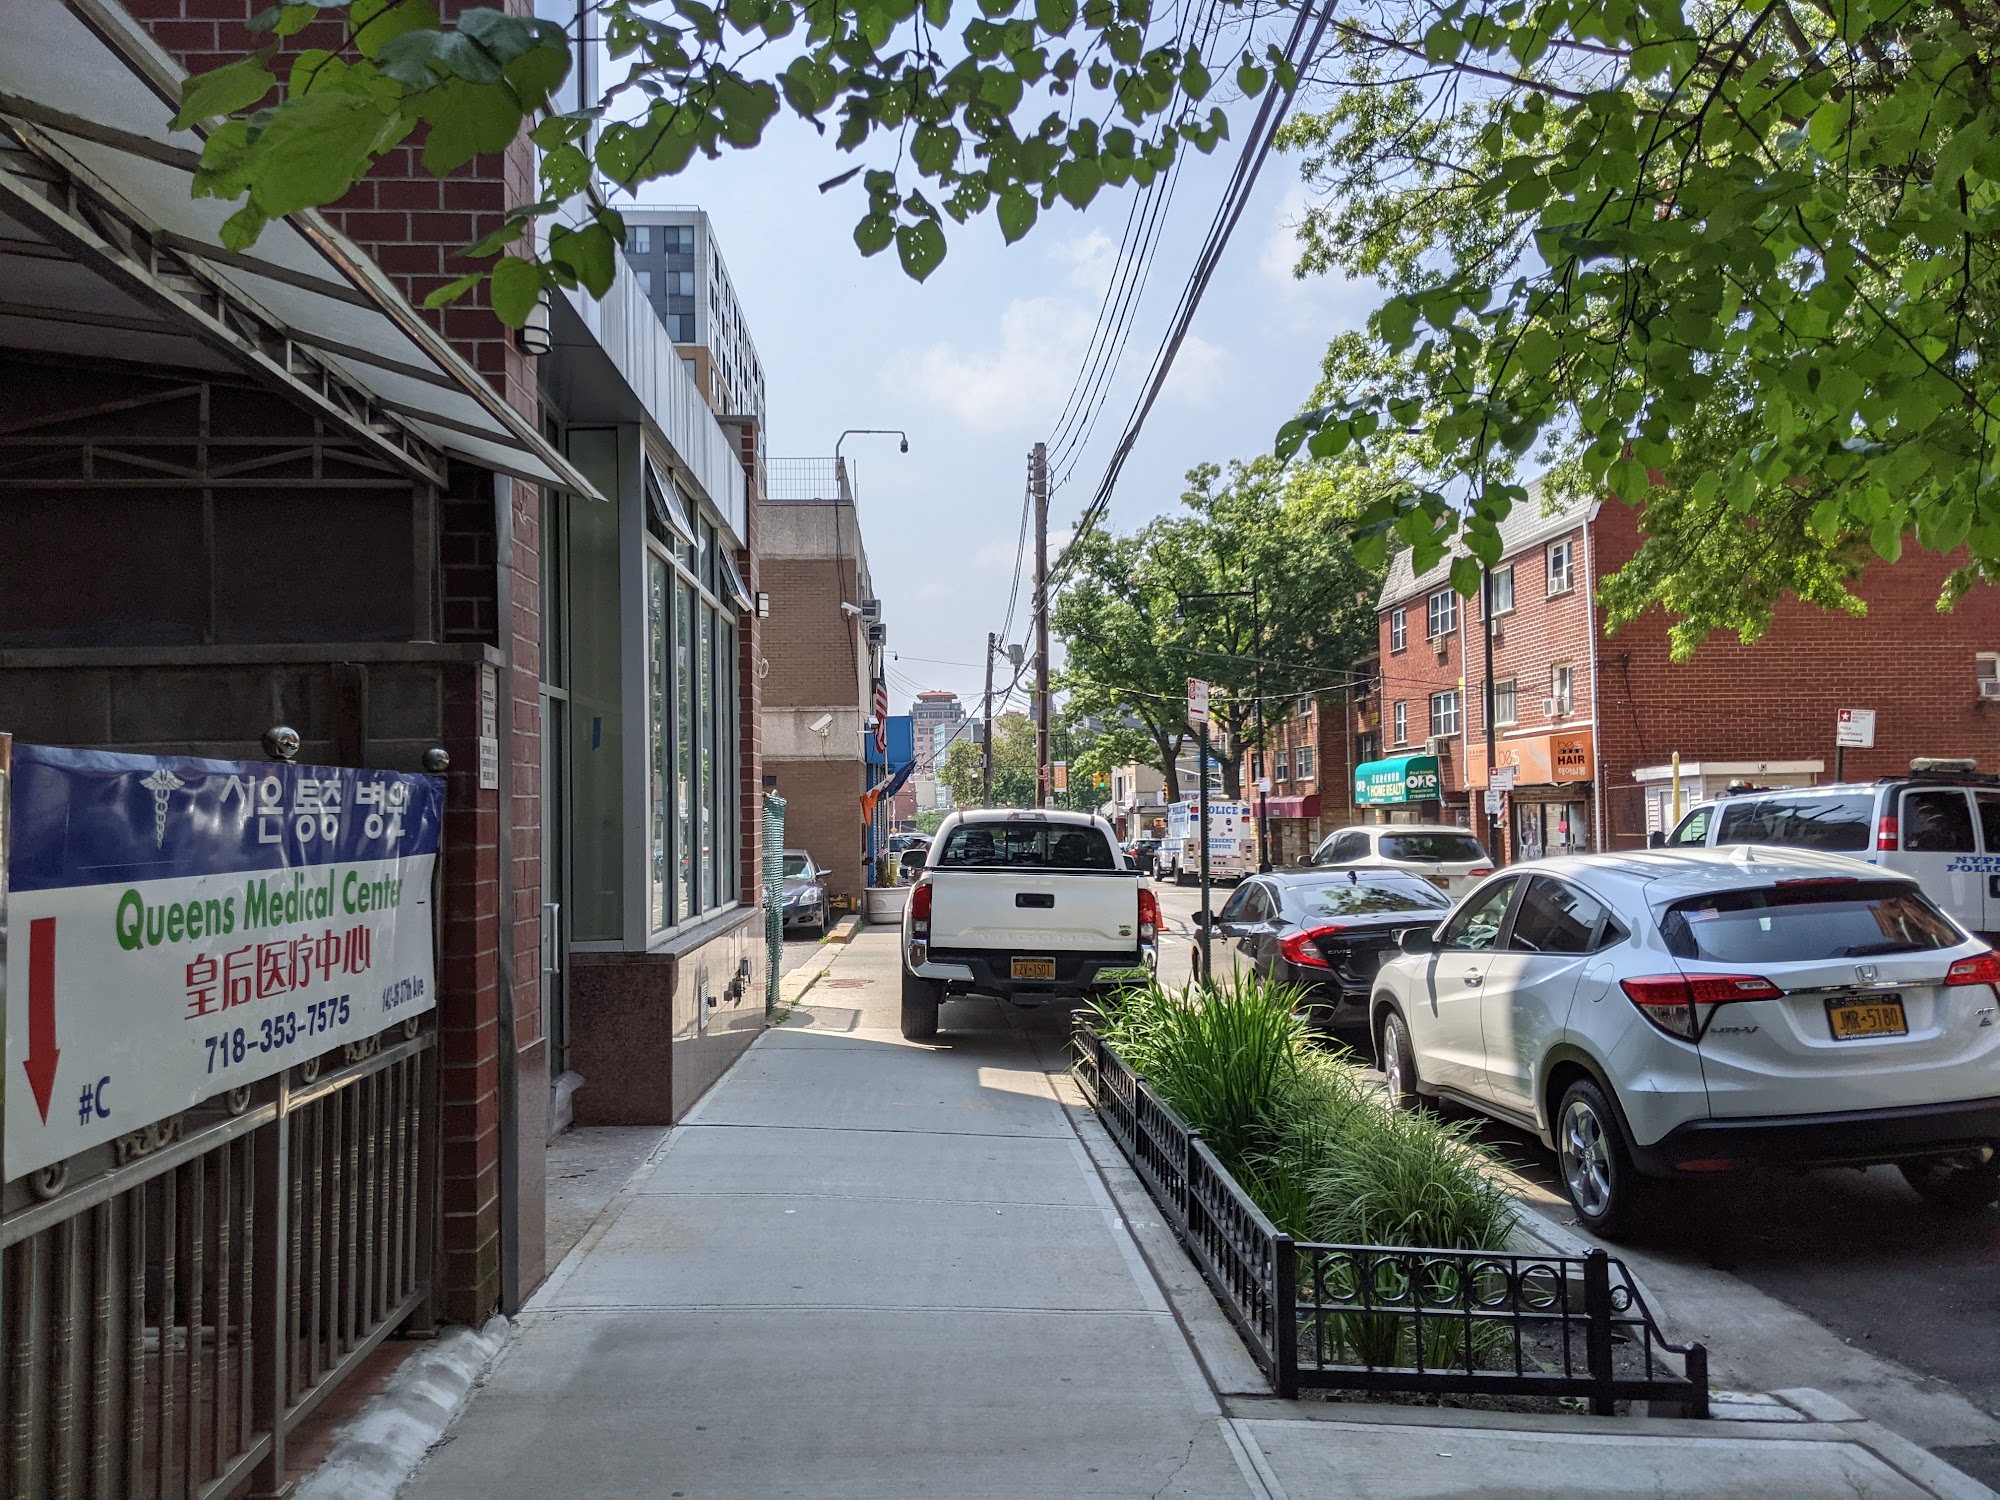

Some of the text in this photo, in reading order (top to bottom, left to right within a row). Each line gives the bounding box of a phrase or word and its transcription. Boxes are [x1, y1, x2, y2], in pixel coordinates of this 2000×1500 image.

[1557, 755, 1585, 765] HAIR
[1370, 783, 1386, 797] HOME
[1386, 781, 1405, 796] REALTY
[220, 774, 410, 844] 시온 통증 병원
[1208, 806, 1238, 815] OLICE
[116, 868, 403, 950] Queens Medical Center
[185, 924, 372, 1020] 皇后医疗中心
[413, 975, 424, 999] Ave
[205, 994, 350, 1074] 718-353-7575
[1710, 1025, 1760, 1036] HR-V
[79, 1075, 111, 1127] #C
